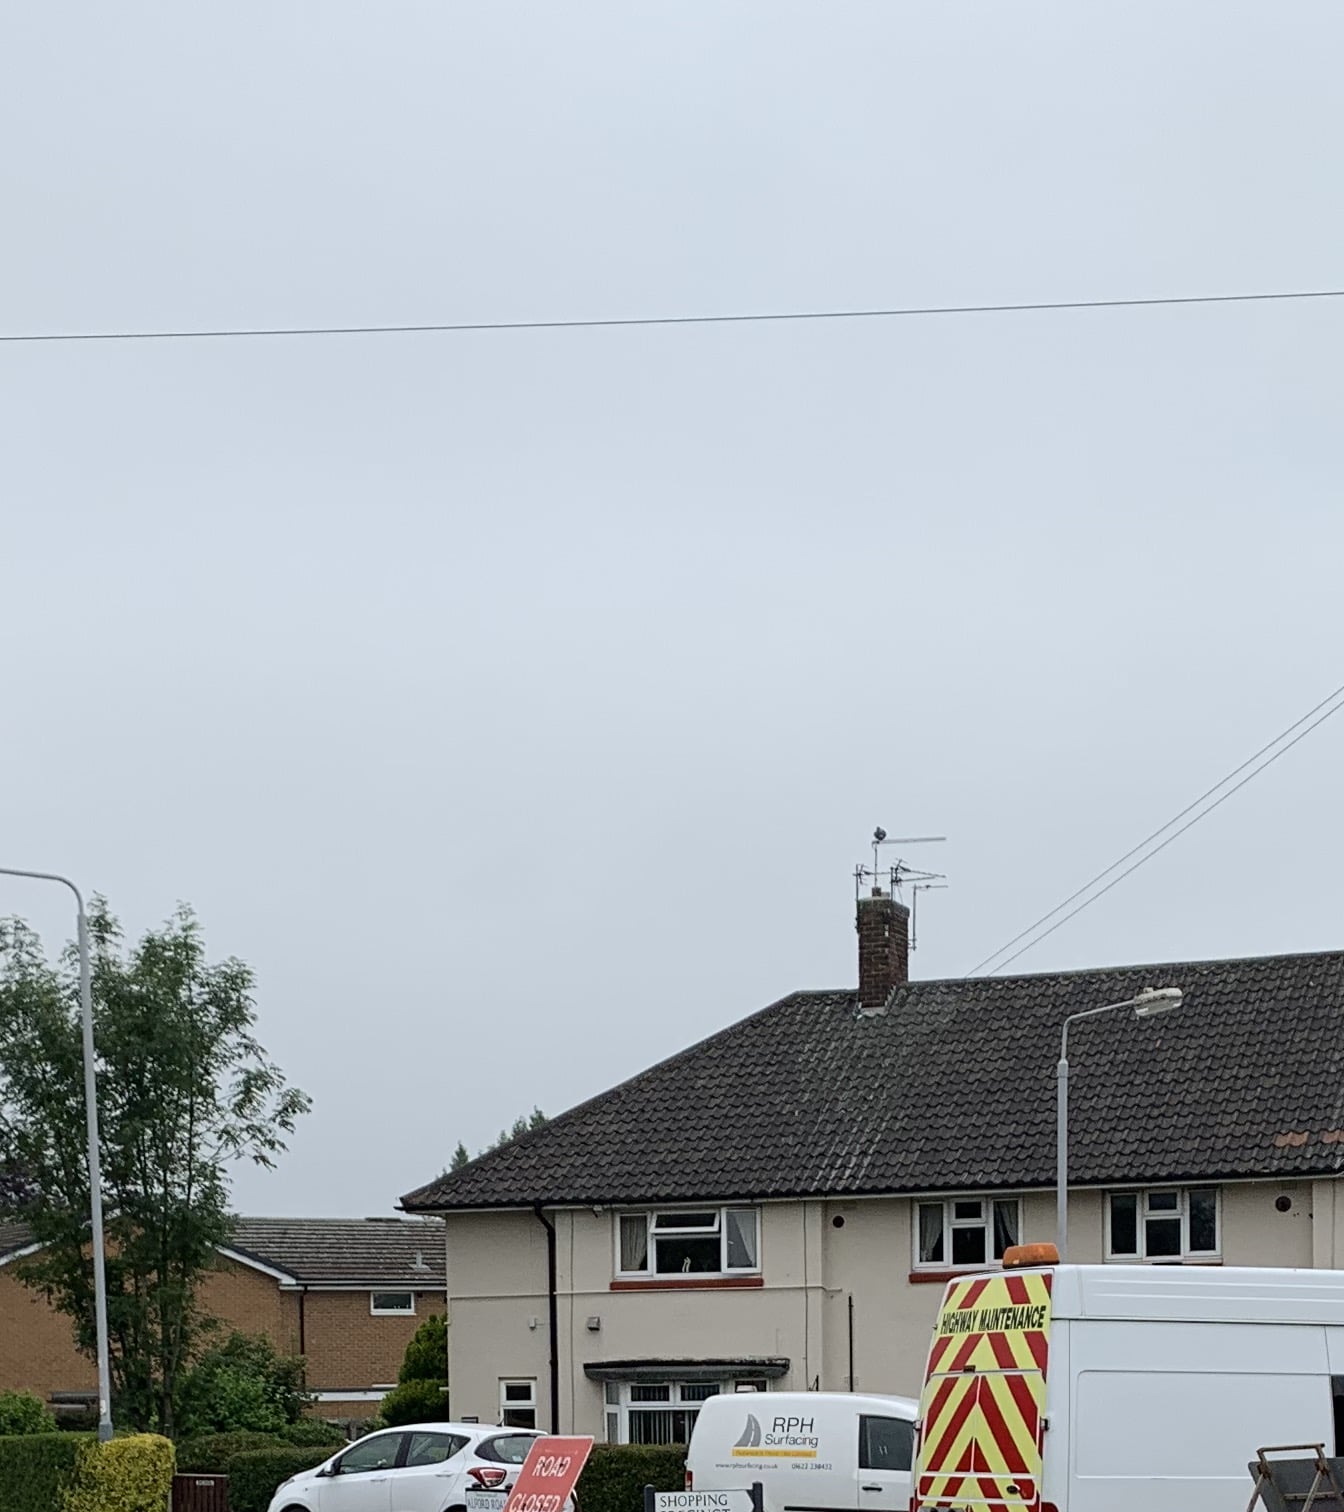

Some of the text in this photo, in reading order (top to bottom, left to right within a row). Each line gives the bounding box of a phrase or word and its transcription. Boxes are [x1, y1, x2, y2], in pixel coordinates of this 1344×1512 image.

[941, 1305, 1047, 1334] HIGHWAY MAINTENANCE
[772, 1416, 815, 1434] RPH
[764, 1433, 819, 1449] Surfacing
[531, 1455, 572, 1478] ROAD
[490, 1498, 506, 1511] ROA
[660, 1494, 728, 1508] SHOPPING
